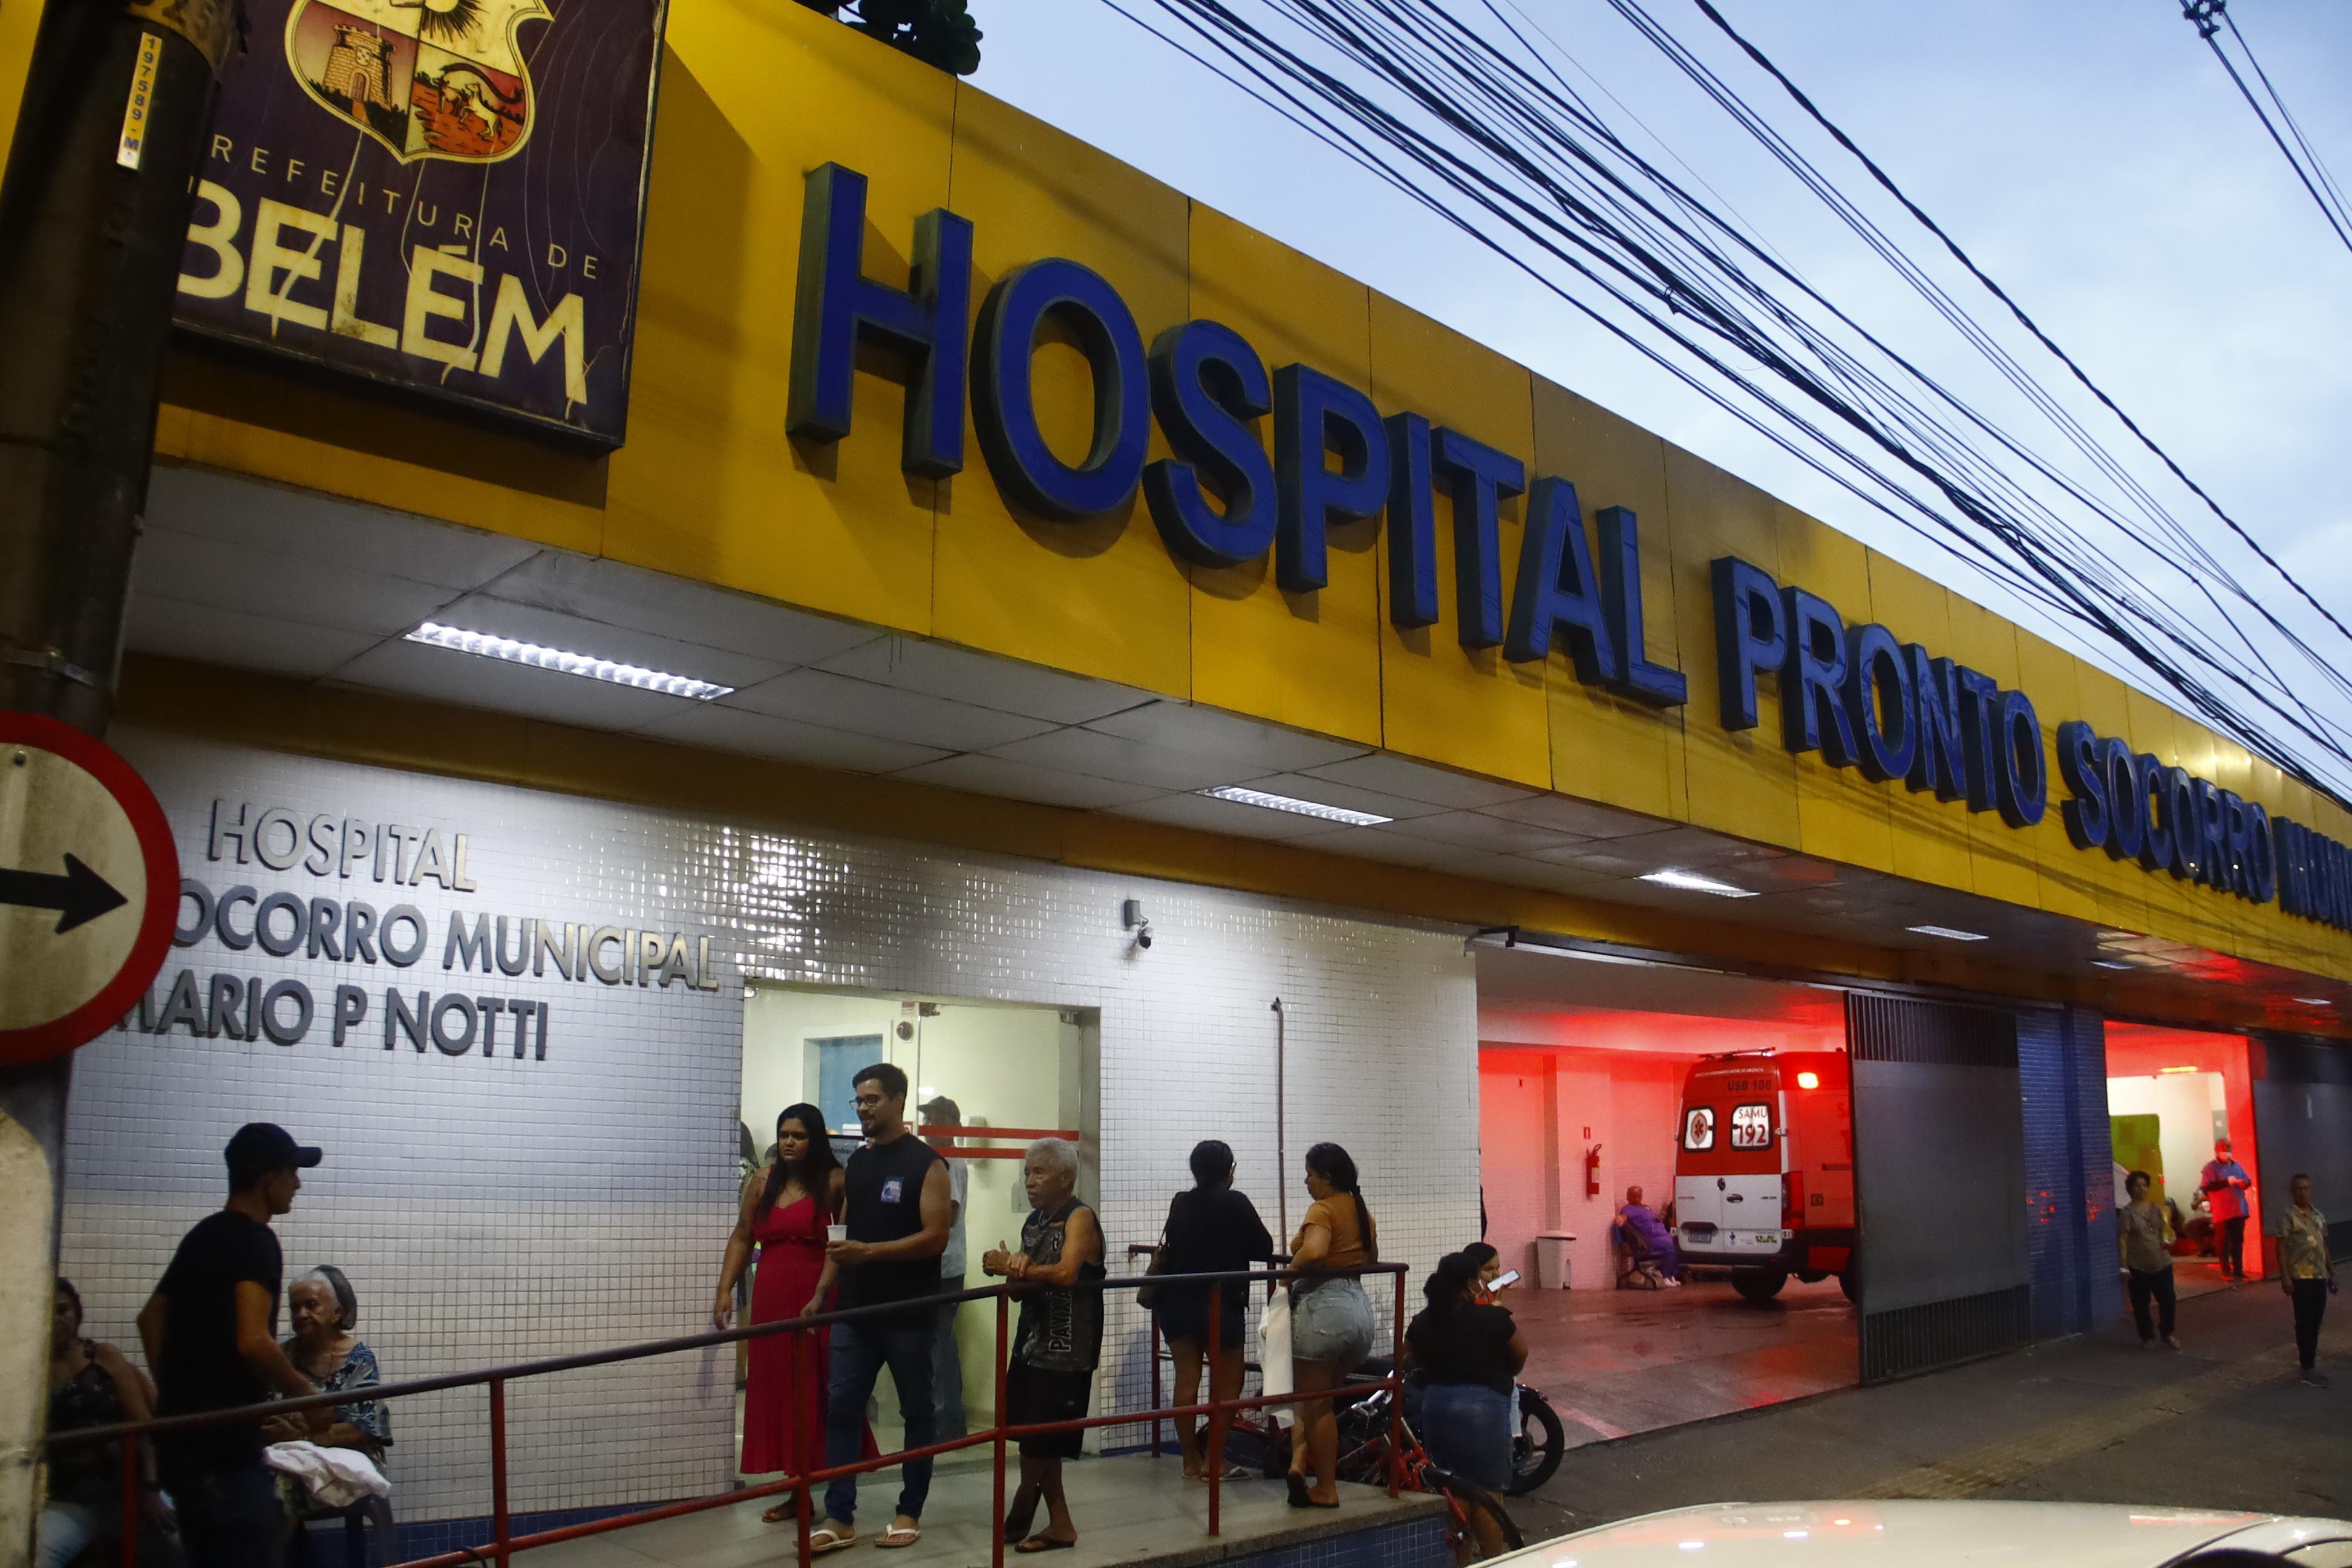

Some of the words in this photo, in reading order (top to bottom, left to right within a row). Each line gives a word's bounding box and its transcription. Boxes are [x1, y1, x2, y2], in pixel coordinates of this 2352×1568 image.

[211, 134, 509, 252] REFEITURA
[547, 243, 598, 279] DE
[177, 179, 587, 404] BELÉM
[785, 161, 1687, 708] HOSPITAL
[1710, 555, 2047, 829] PRONTO
[2057, 720, 2275, 905] SOCORRO
[207, 798, 477, 892] HOSPITAL
[172, 878, 428, 967] OCORRO
[442, 910, 718, 991] MUNICIPAL
[333, 984, 368, 1047] P
[385, 987, 548, 1061] NOTTI
[1728, 1080, 1748, 1091] USB
[1738, 1107, 1767, 1118] SAMU
[1738, 1124, 1766, 1144] 192
